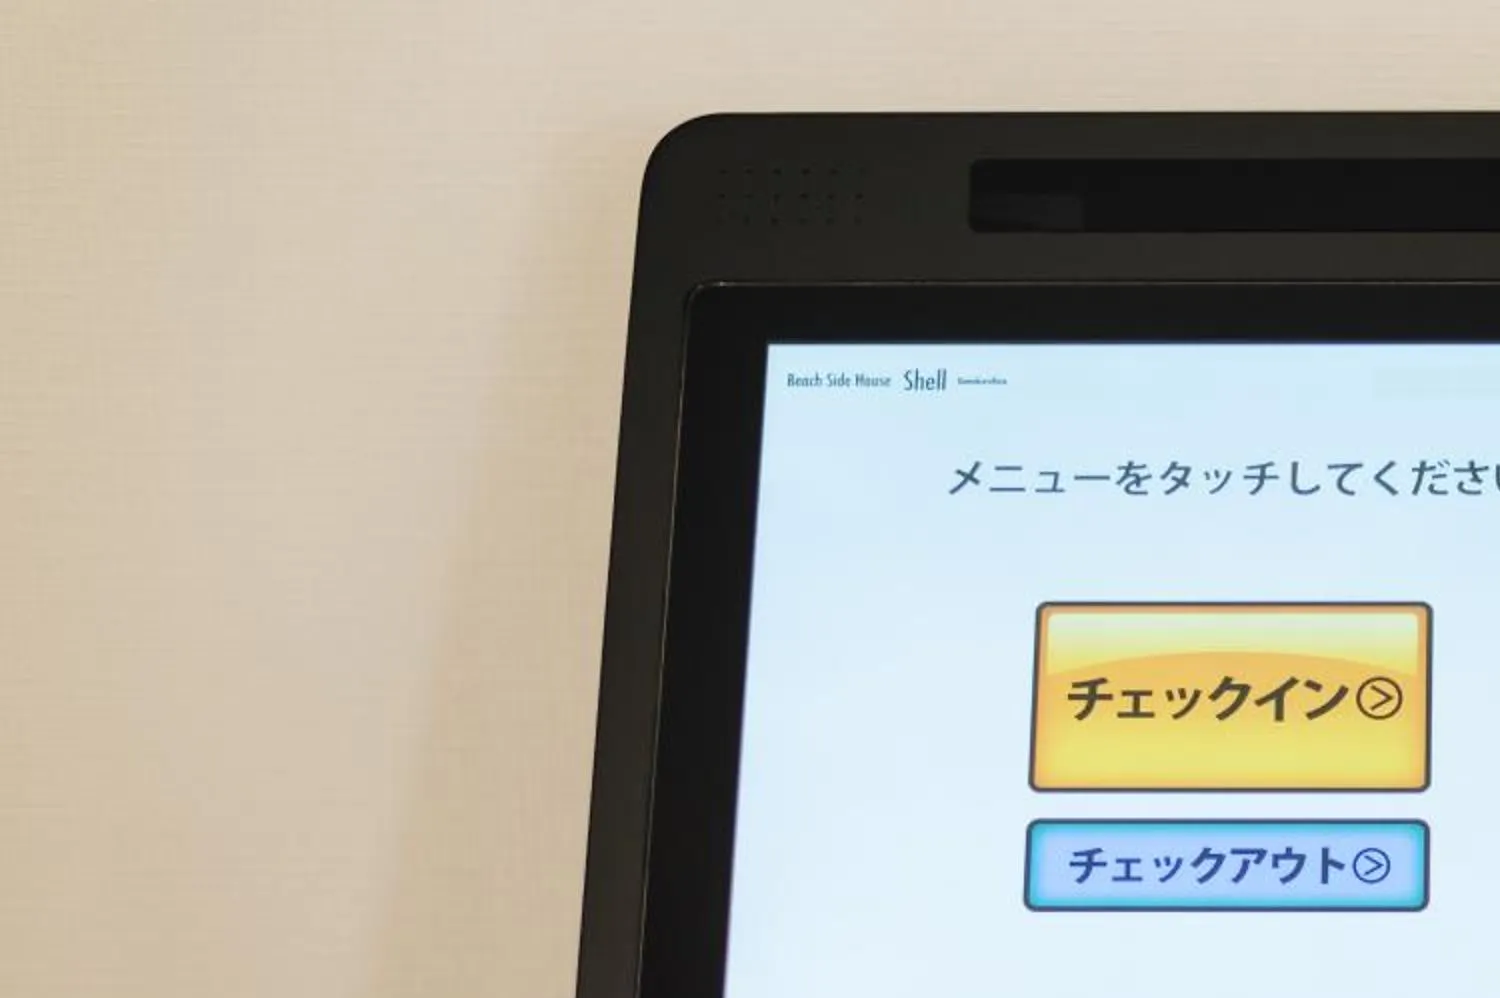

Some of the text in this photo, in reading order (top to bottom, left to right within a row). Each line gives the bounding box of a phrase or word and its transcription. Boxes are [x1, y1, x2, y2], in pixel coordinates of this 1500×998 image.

[787, 372, 823, 387] Beach
[826, 372, 851, 387] Side
[855, 373, 891, 387] House
[903, 368, 947, 391] Shell
[1066, 675, 1350, 723] チェックイン
[1068, 846, 1346, 885] チェックアウト
